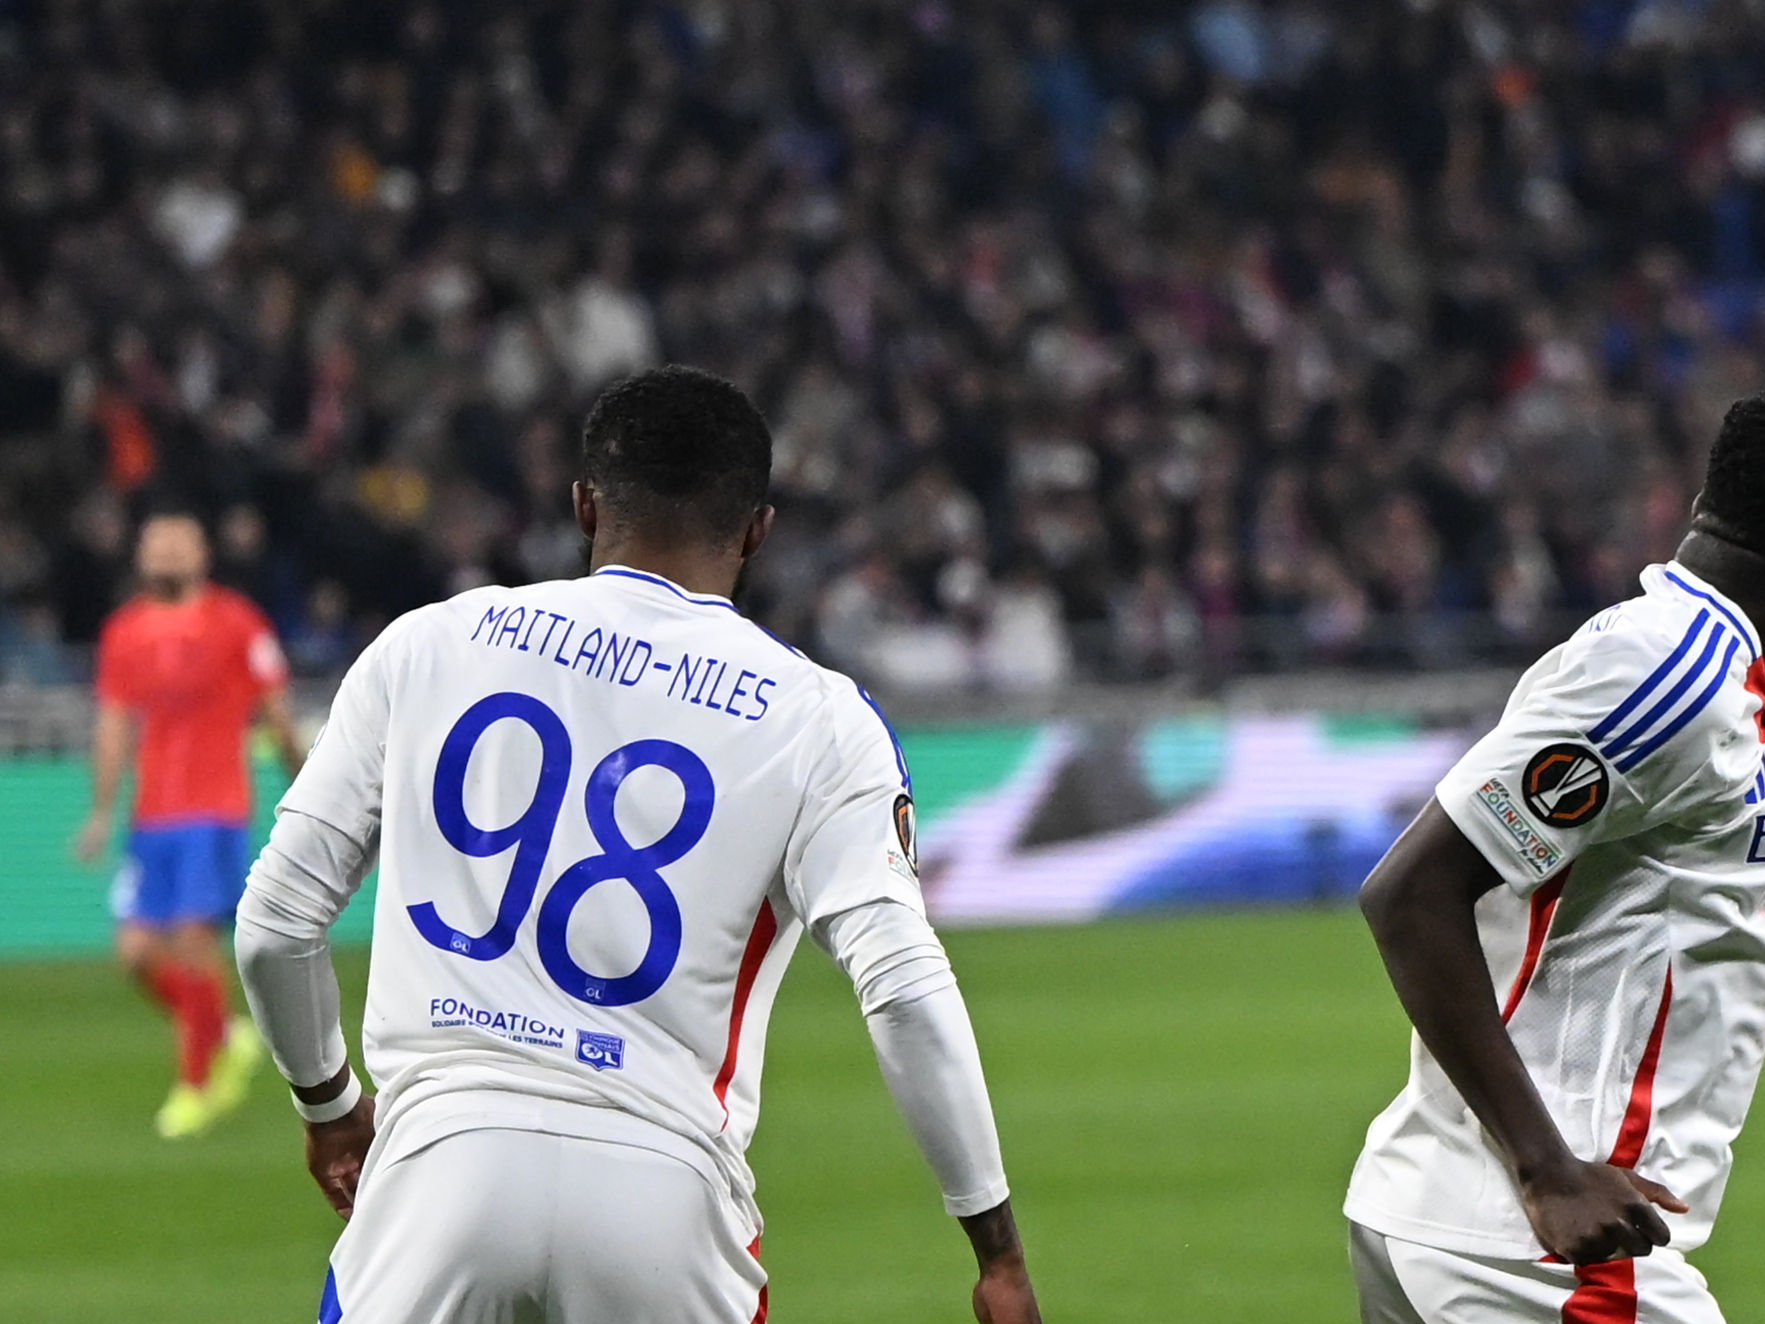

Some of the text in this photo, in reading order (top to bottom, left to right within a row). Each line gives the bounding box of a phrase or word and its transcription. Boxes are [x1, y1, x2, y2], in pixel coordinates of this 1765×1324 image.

[471, 604, 777, 721] MAITLAND-NILES
[405, 691, 716, 1007] 98
[1480, 782, 1557, 869] FOUNDATION
[430, 997, 565, 1040] FONDATION
